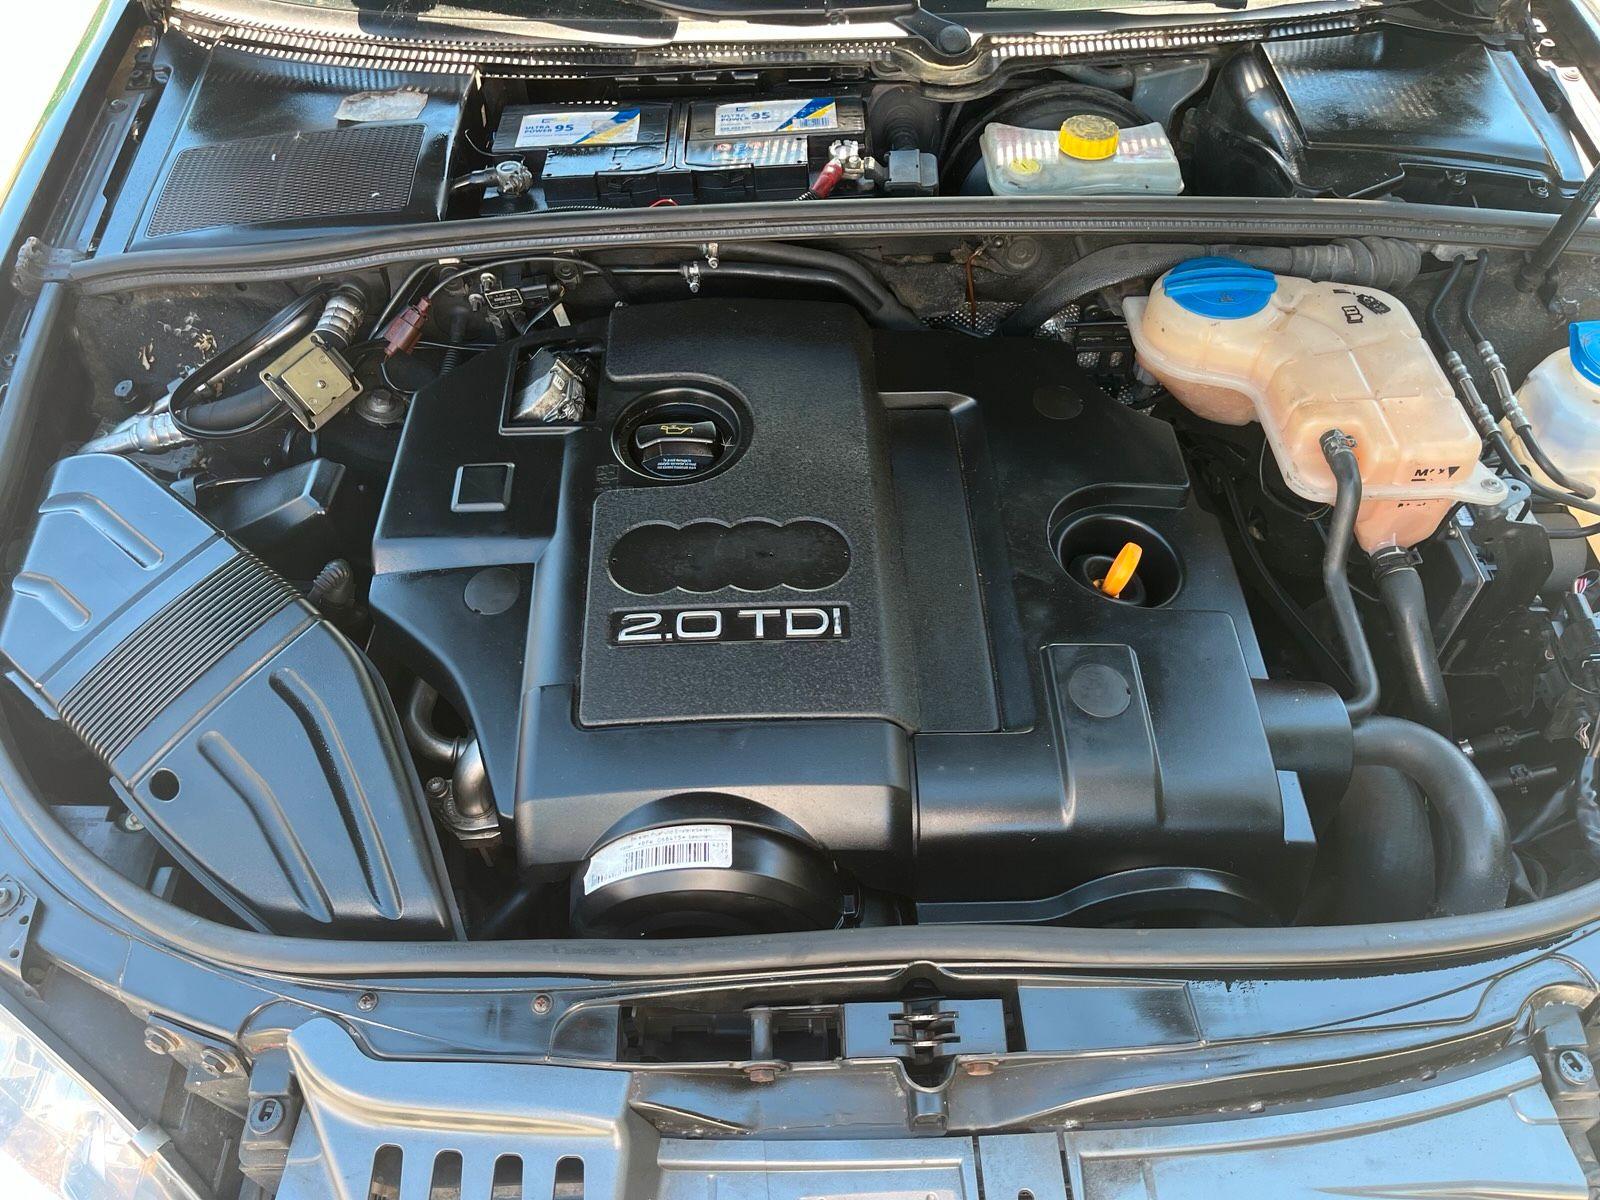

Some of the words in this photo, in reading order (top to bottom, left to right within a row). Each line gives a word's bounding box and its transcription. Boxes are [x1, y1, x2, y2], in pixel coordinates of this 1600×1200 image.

[751, 111, 771, 120] 95
[554, 123, 575, 132] 95
[617, 611, 722, 643] 2.0
[737, 607, 843, 639] TDI
